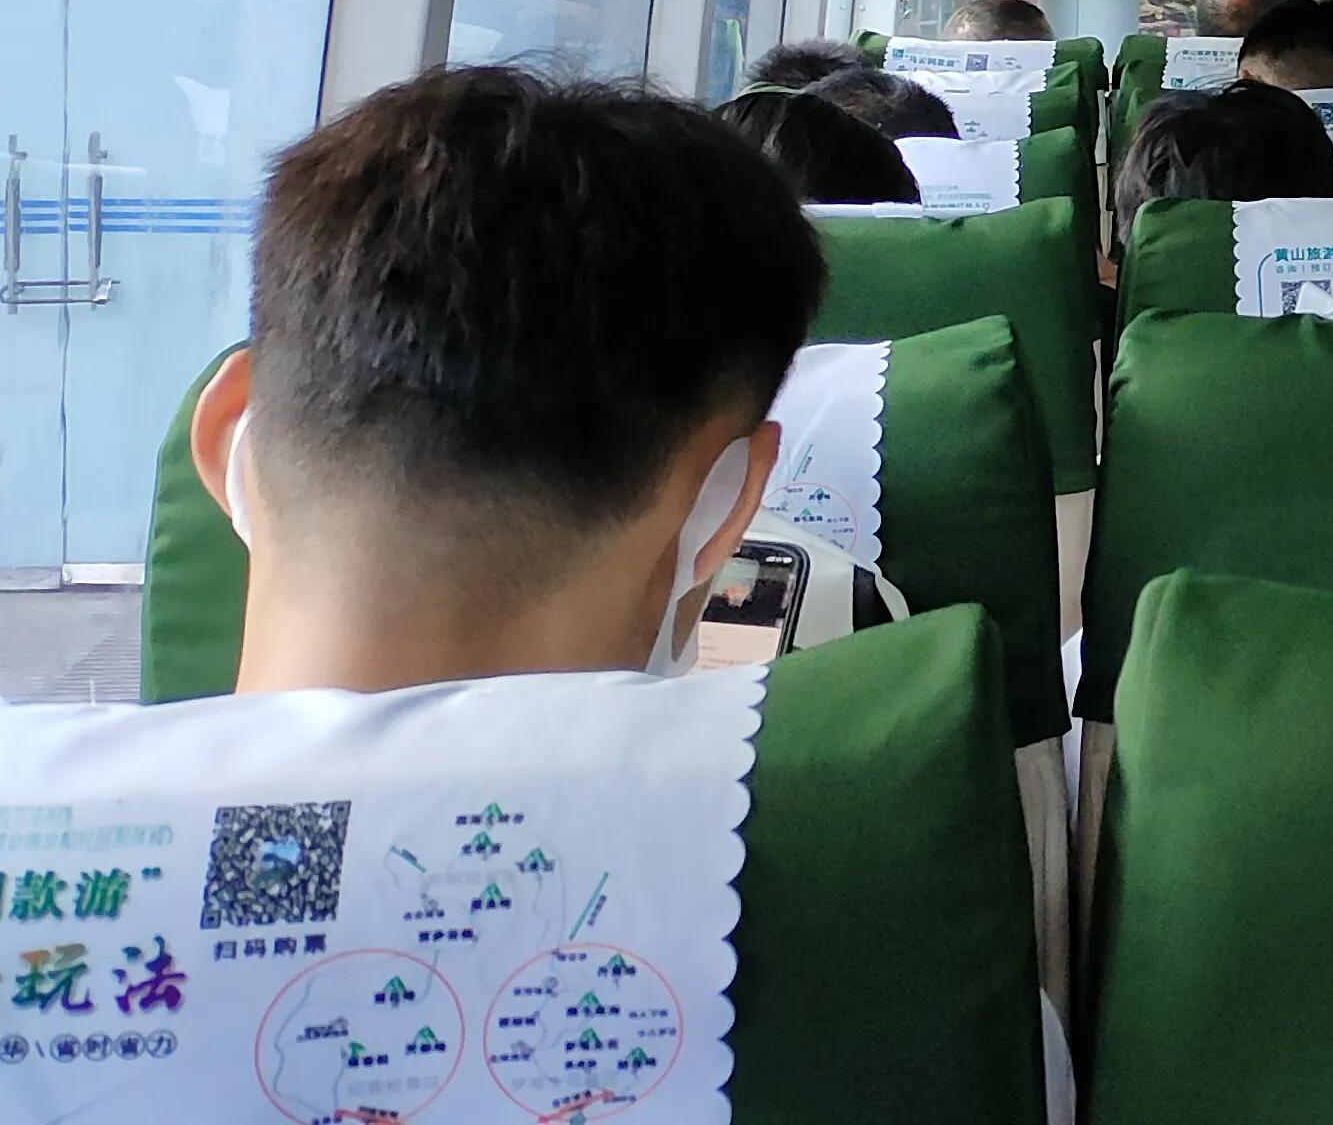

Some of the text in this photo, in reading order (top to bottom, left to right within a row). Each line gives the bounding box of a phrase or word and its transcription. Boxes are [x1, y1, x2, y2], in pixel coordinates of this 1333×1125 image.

[0, 867, 162, 920] 款游”
[213, 933, 327, 962] 扫码购票
